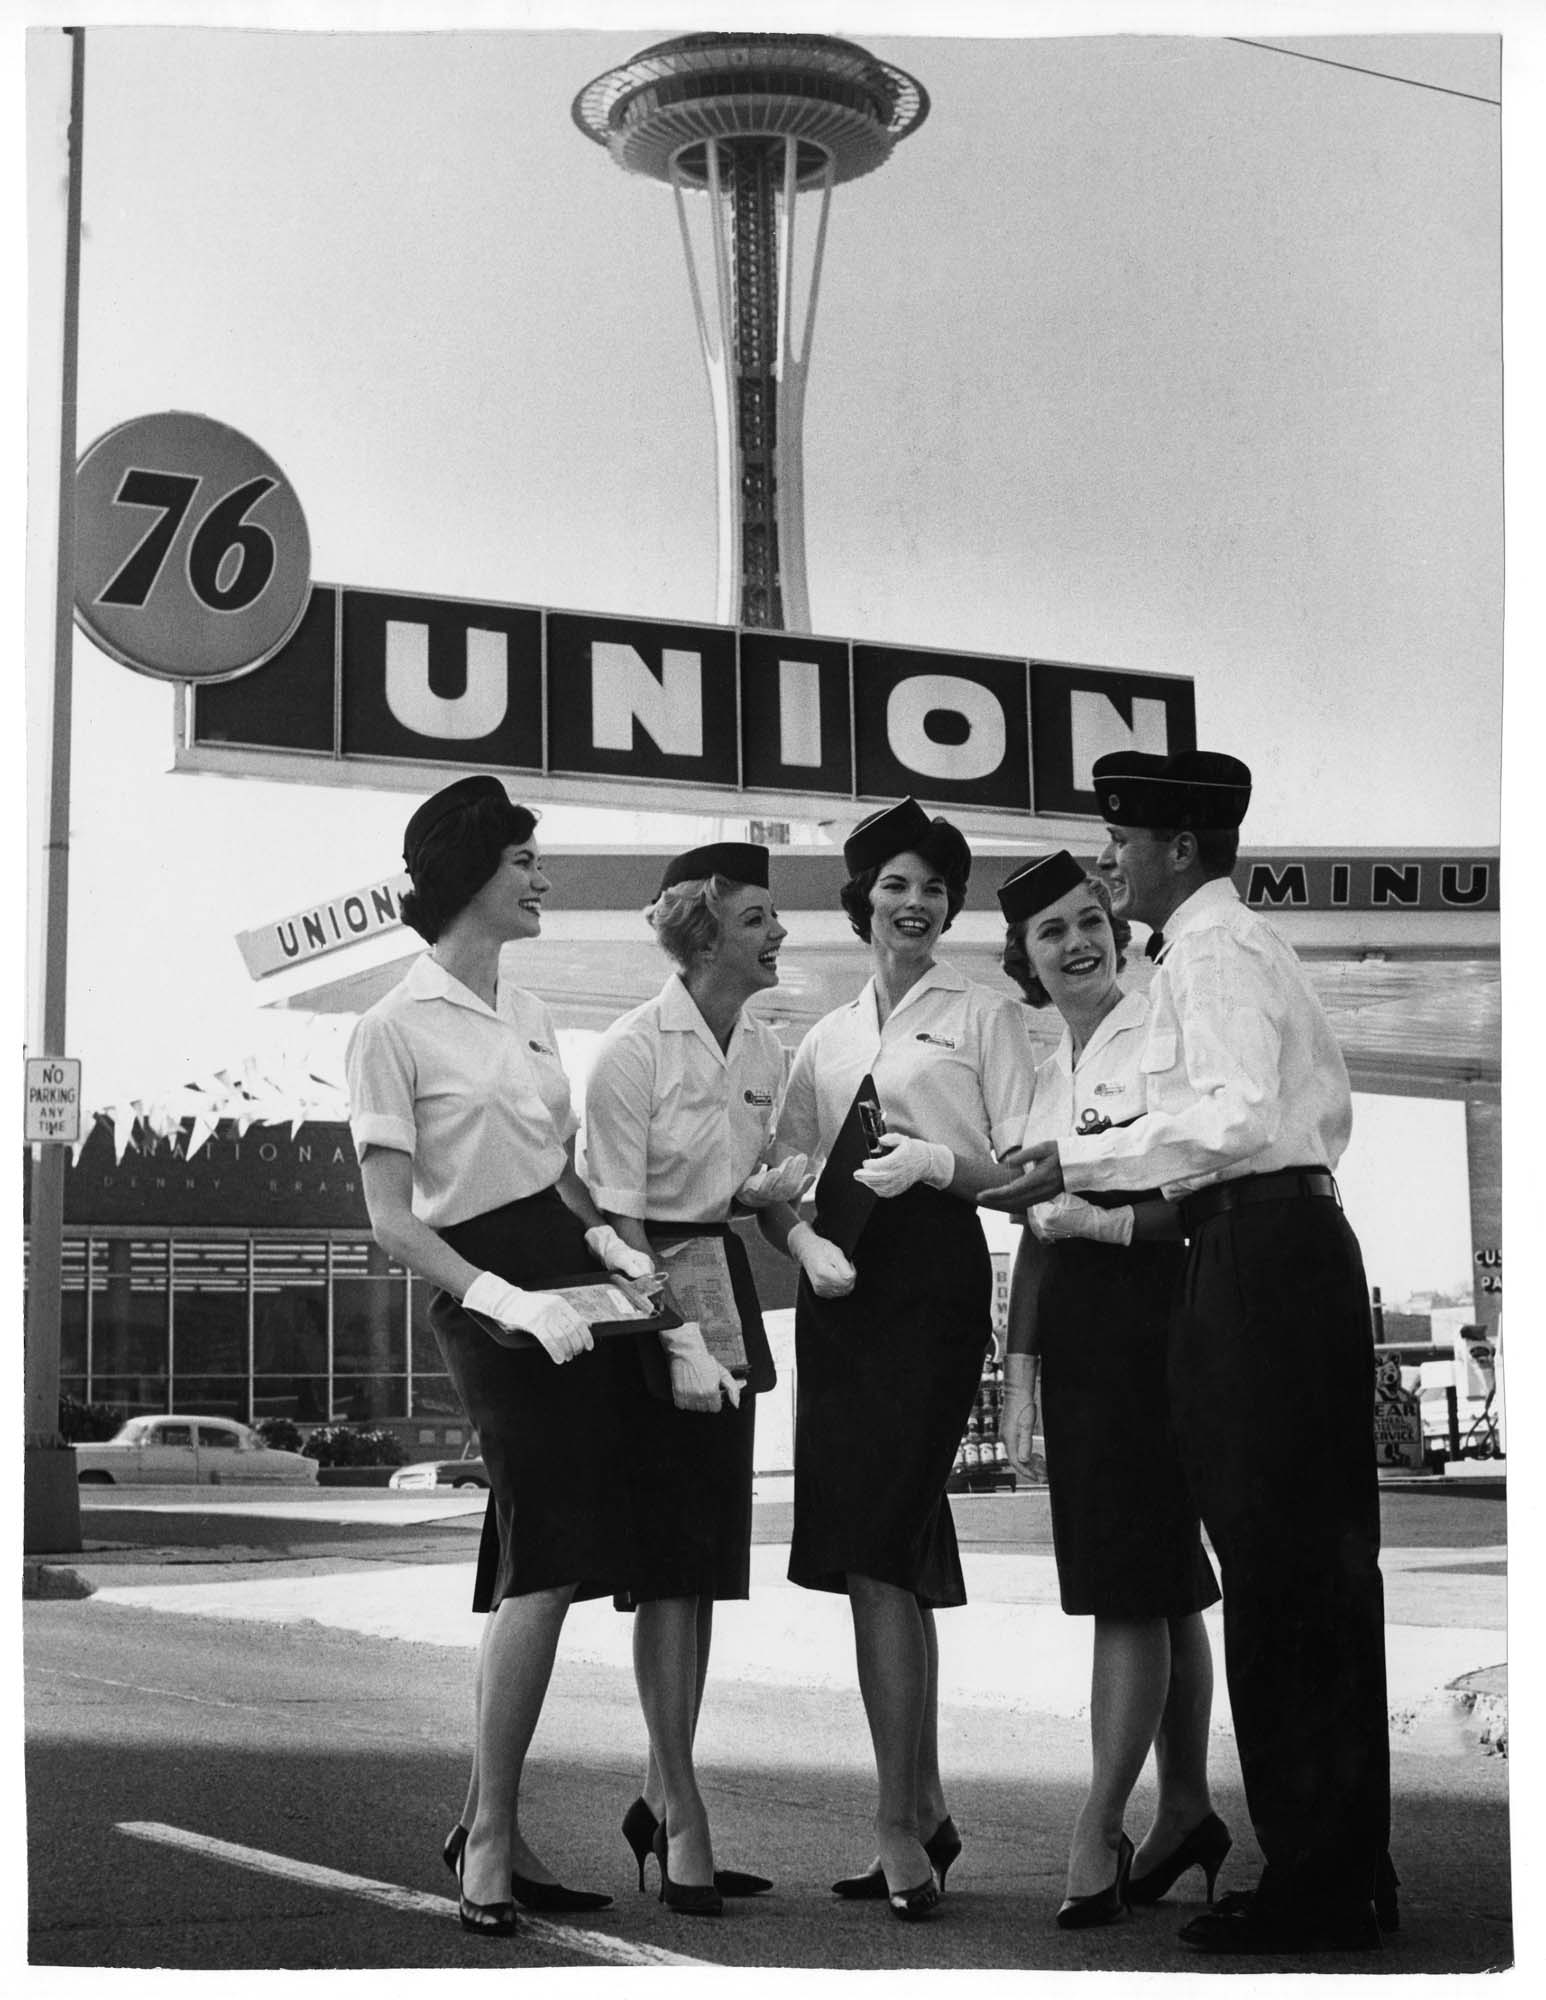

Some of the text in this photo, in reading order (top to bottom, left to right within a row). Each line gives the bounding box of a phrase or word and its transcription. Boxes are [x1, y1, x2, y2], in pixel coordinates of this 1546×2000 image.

[93, 468, 280, 612] 76
[385, 620, 1168, 792] UNION
[1246, 864, 1490, 905] MINU
[277, 886, 397, 957] UNION
[43, 1068, 64, 1084] NO
[29, 1087, 75, 1103] PARKING
[40, 1107, 64, 1118] ANY
[39, 1120, 64, 1132] TIME
[143, 1139, 345, 1163] NATIONA
[103, 1176, 221, 1190] DENNY
